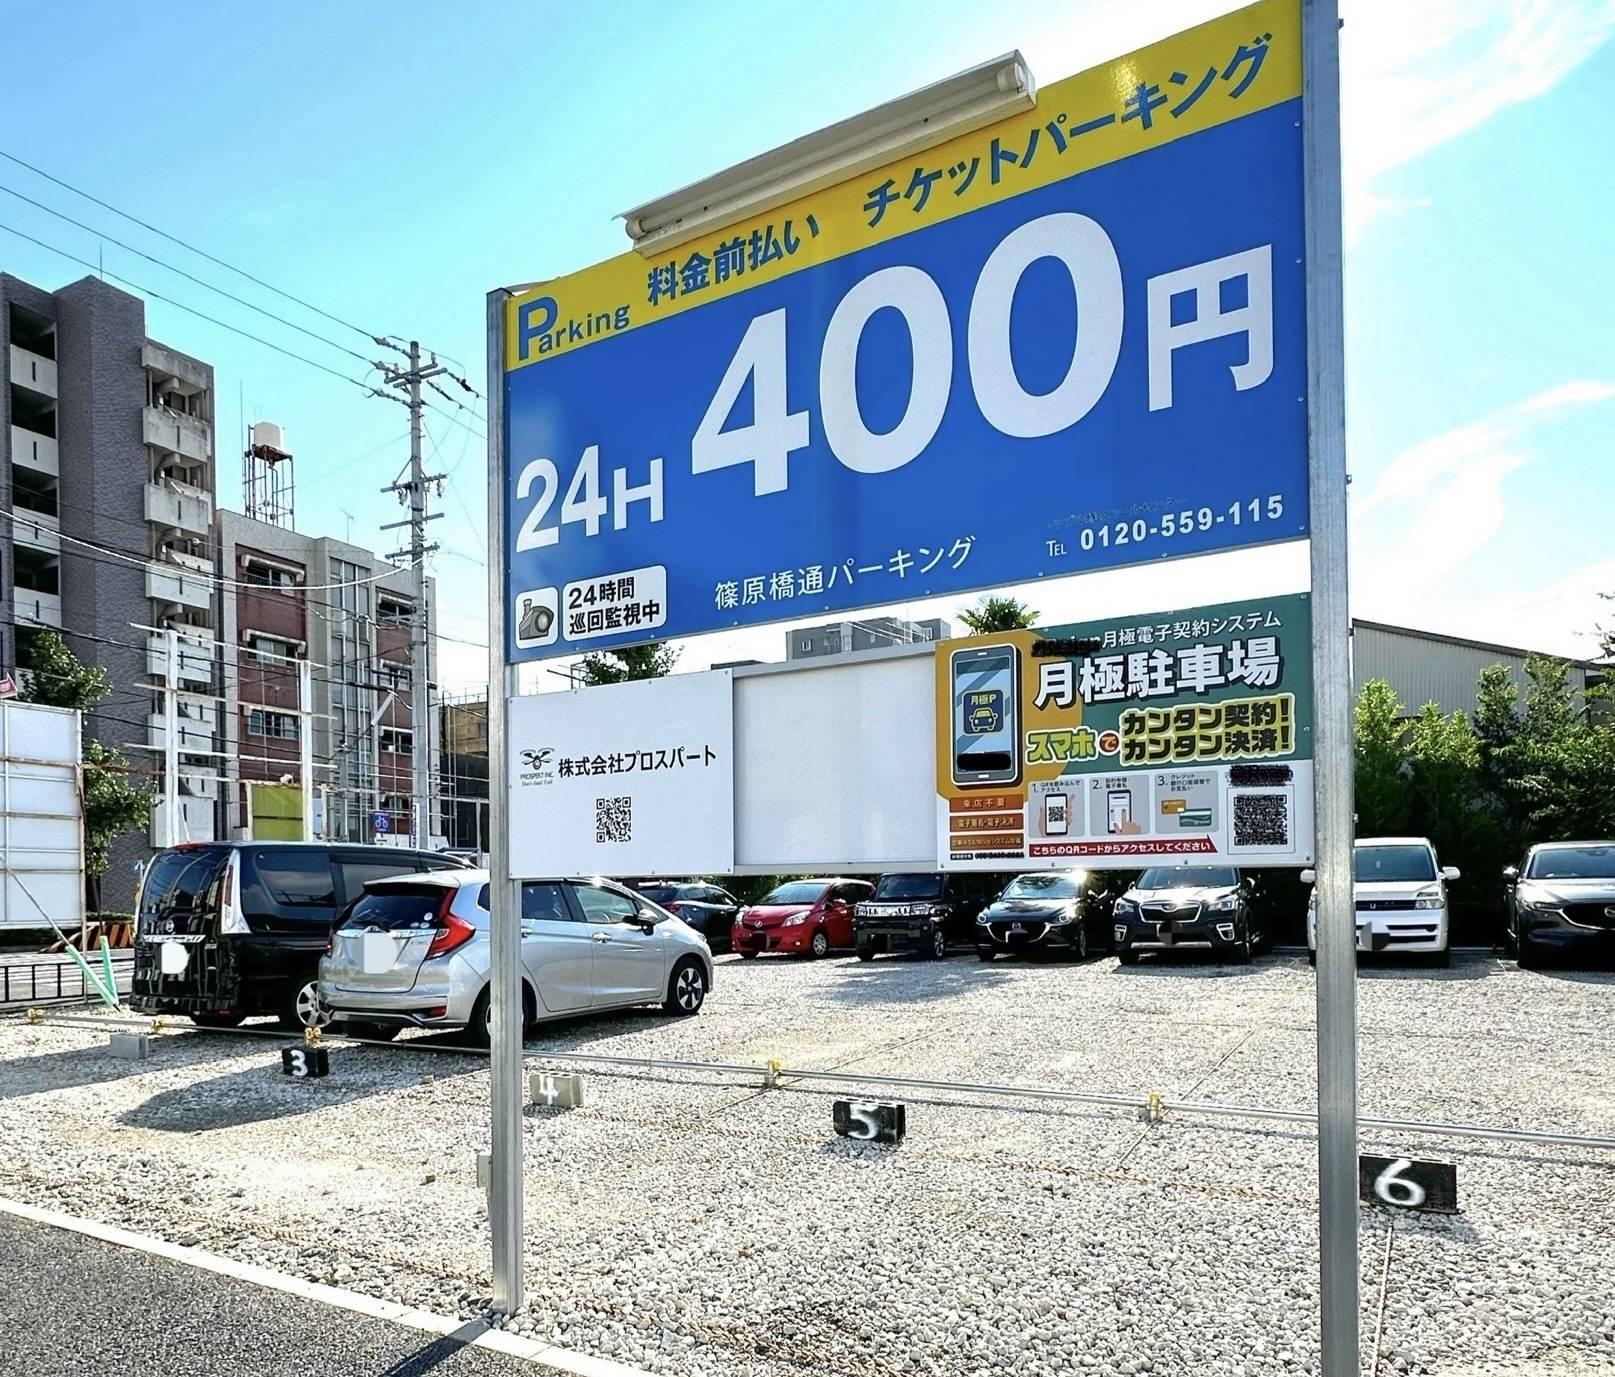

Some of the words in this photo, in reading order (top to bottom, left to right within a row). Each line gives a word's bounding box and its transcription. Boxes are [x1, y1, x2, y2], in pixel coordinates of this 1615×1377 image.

[647, 213, 818, 307] 料金前払い
[863, 33, 1275, 227] チケットパーキング
[517, 296, 630, 362] Parking
[515, 443, 665, 551] 24H
[690, 211, 1275, 499] 400円
[1080, 494, 1284, 551] 0120-559-115
[714, 534, 976, 610] 篠原橋通パーキング
[568, 576, 635, 610] 24時間
[569, 600, 660, 636] 巡回監視中
[1101, 610, 1282, 649] 月極電子契約システム
[1033, 637, 1281, 709] 月極駐車場
[558, 744, 716, 778] 株式会社プロスパート
[1033, 841, 1211, 856] こちらのQRコードからアクセスしてください
[290, 1049, 310, 1078] 3
[538, 1076, 561, 1105] 4
[847, 1103, 880, 1140] 5
[1374, 1159, 1426, 1207] 6
